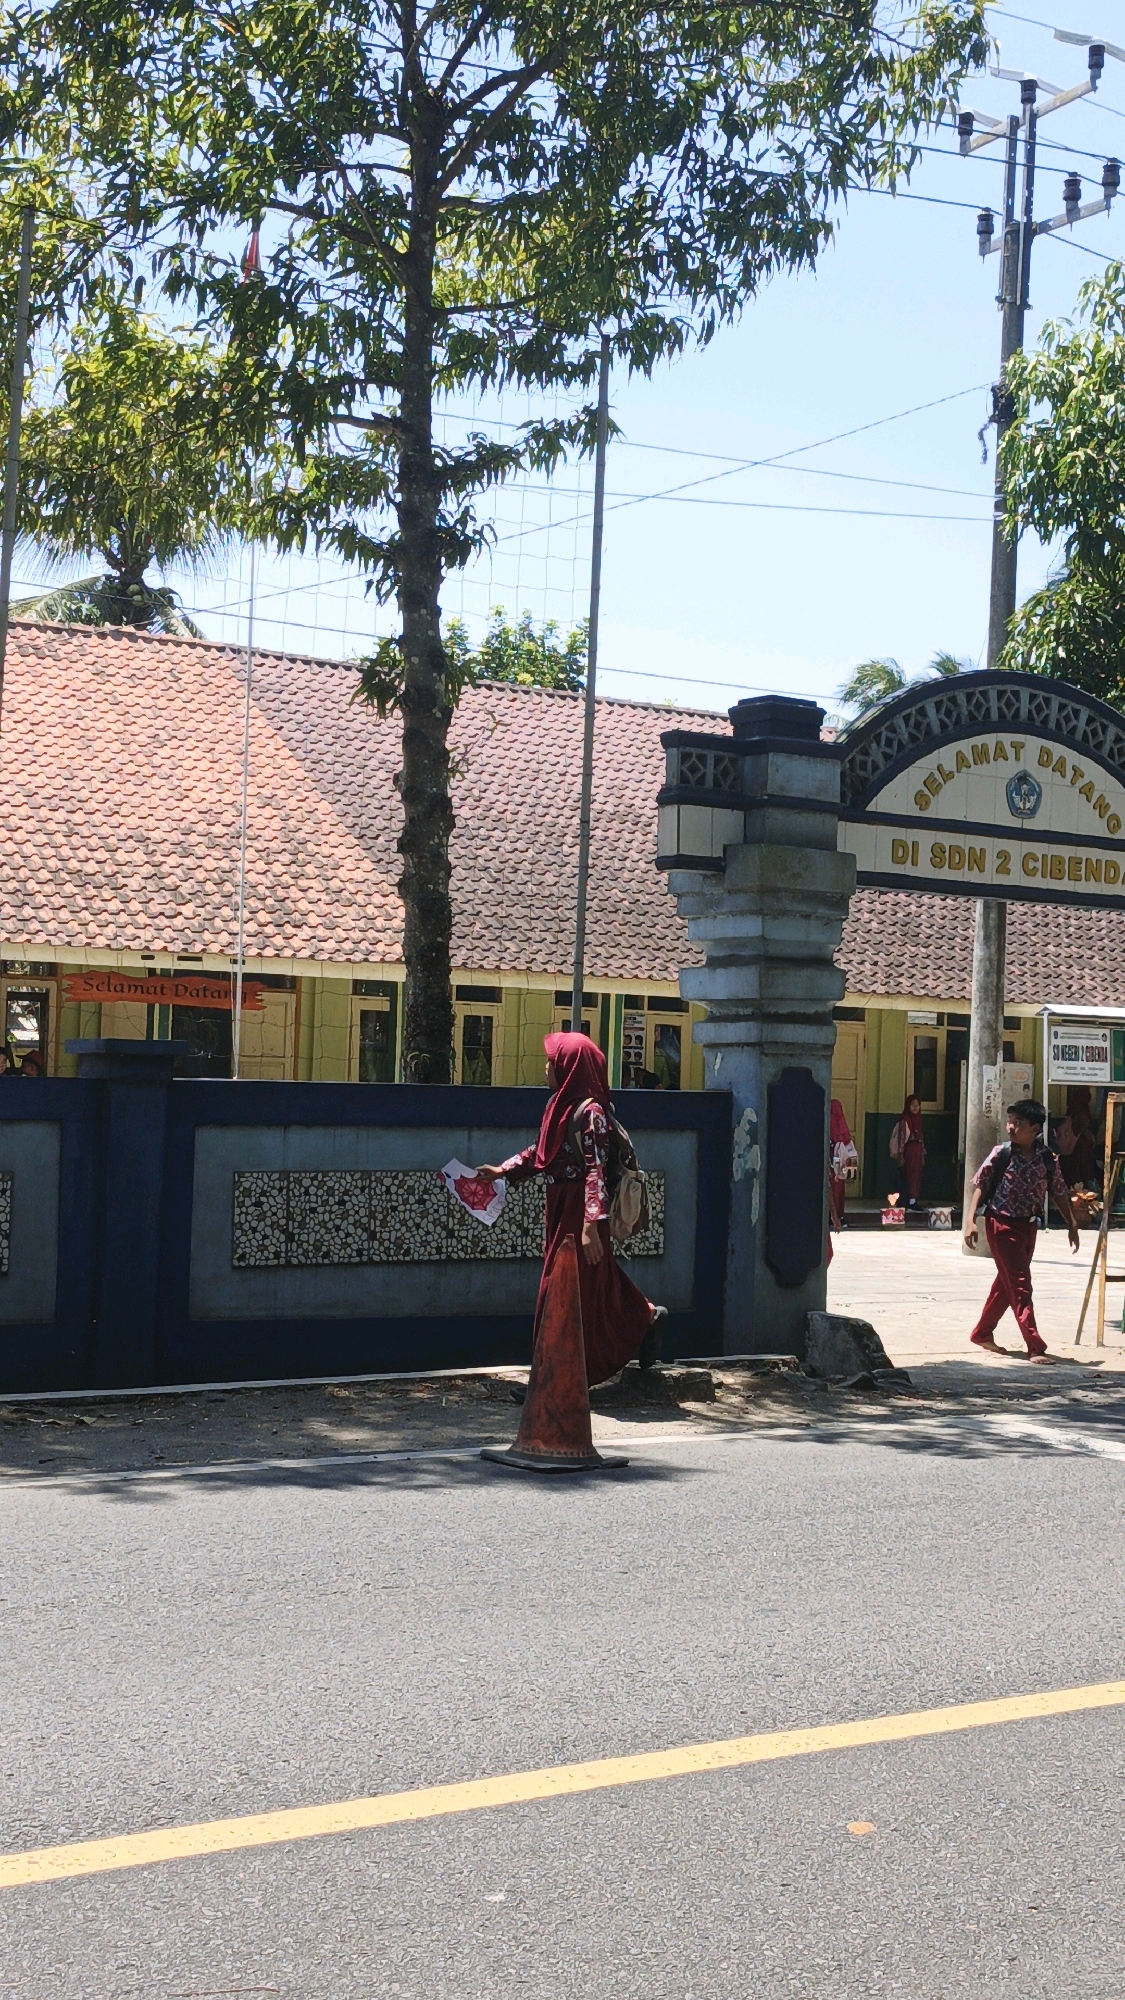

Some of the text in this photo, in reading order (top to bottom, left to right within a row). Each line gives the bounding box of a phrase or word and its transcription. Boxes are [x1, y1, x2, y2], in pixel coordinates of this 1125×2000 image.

[914, 740, 1122, 834] SELAMAT DATANG
[892, 838, 1125, 885] DI SDN 2 CIBEND
[82, 974, 167, 995] Selamat
